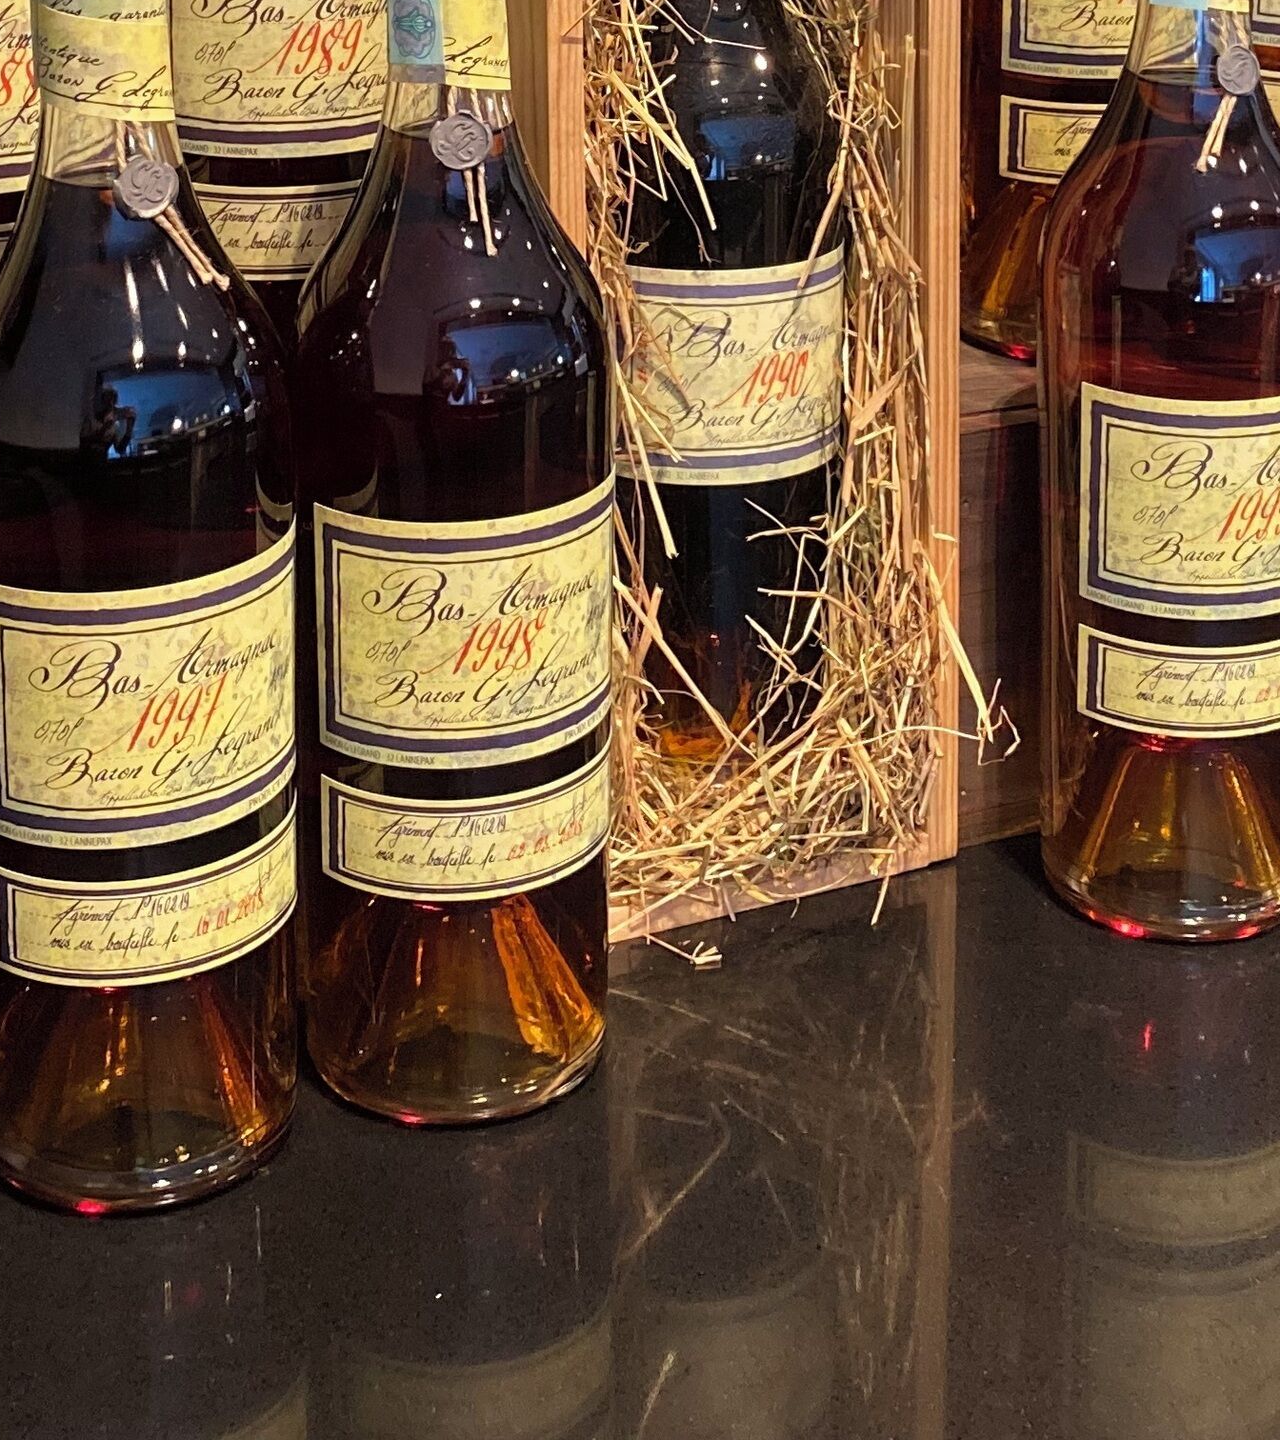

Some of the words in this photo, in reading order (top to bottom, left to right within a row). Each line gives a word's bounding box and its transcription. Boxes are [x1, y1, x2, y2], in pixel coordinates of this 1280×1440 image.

[258, 18, 366, 76] 1989
[39, 55, 85, 87] Baron
[192, 68, 287, 104] Baron
[721, 350, 810, 408] 1990
[1141, 531, 1224, 566] Baron
[434, 607, 549, 676] 1998
[364, 669, 466, 709] Baron
[104, 672, 231, 754] 1997
[35, 747, 143, 790] Baron
